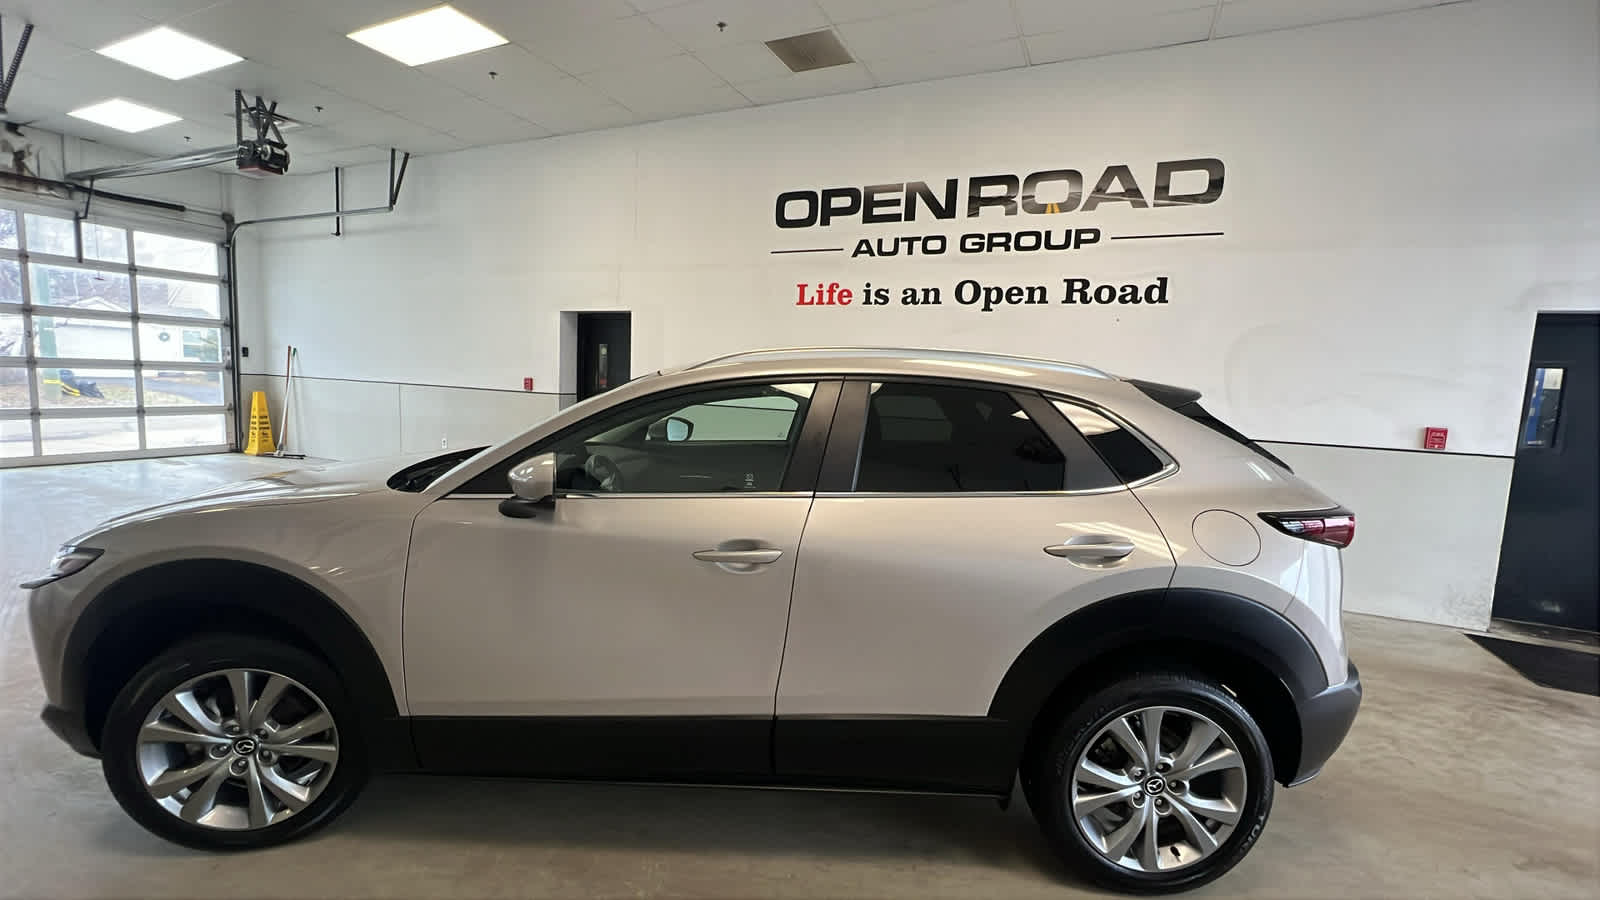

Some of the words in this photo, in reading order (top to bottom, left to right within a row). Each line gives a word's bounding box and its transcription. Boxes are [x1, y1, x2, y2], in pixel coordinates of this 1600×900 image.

[851, 233, 949, 259] AUTO
[959, 227, 1101, 254] GROUP
[795, 282, 853, 306] Life
[861, 282, 890, 306] is
[900, 287, 943, 306] an
[954, 279, 1049, 312] Open
[1061, 277, 1169, 305] Road
